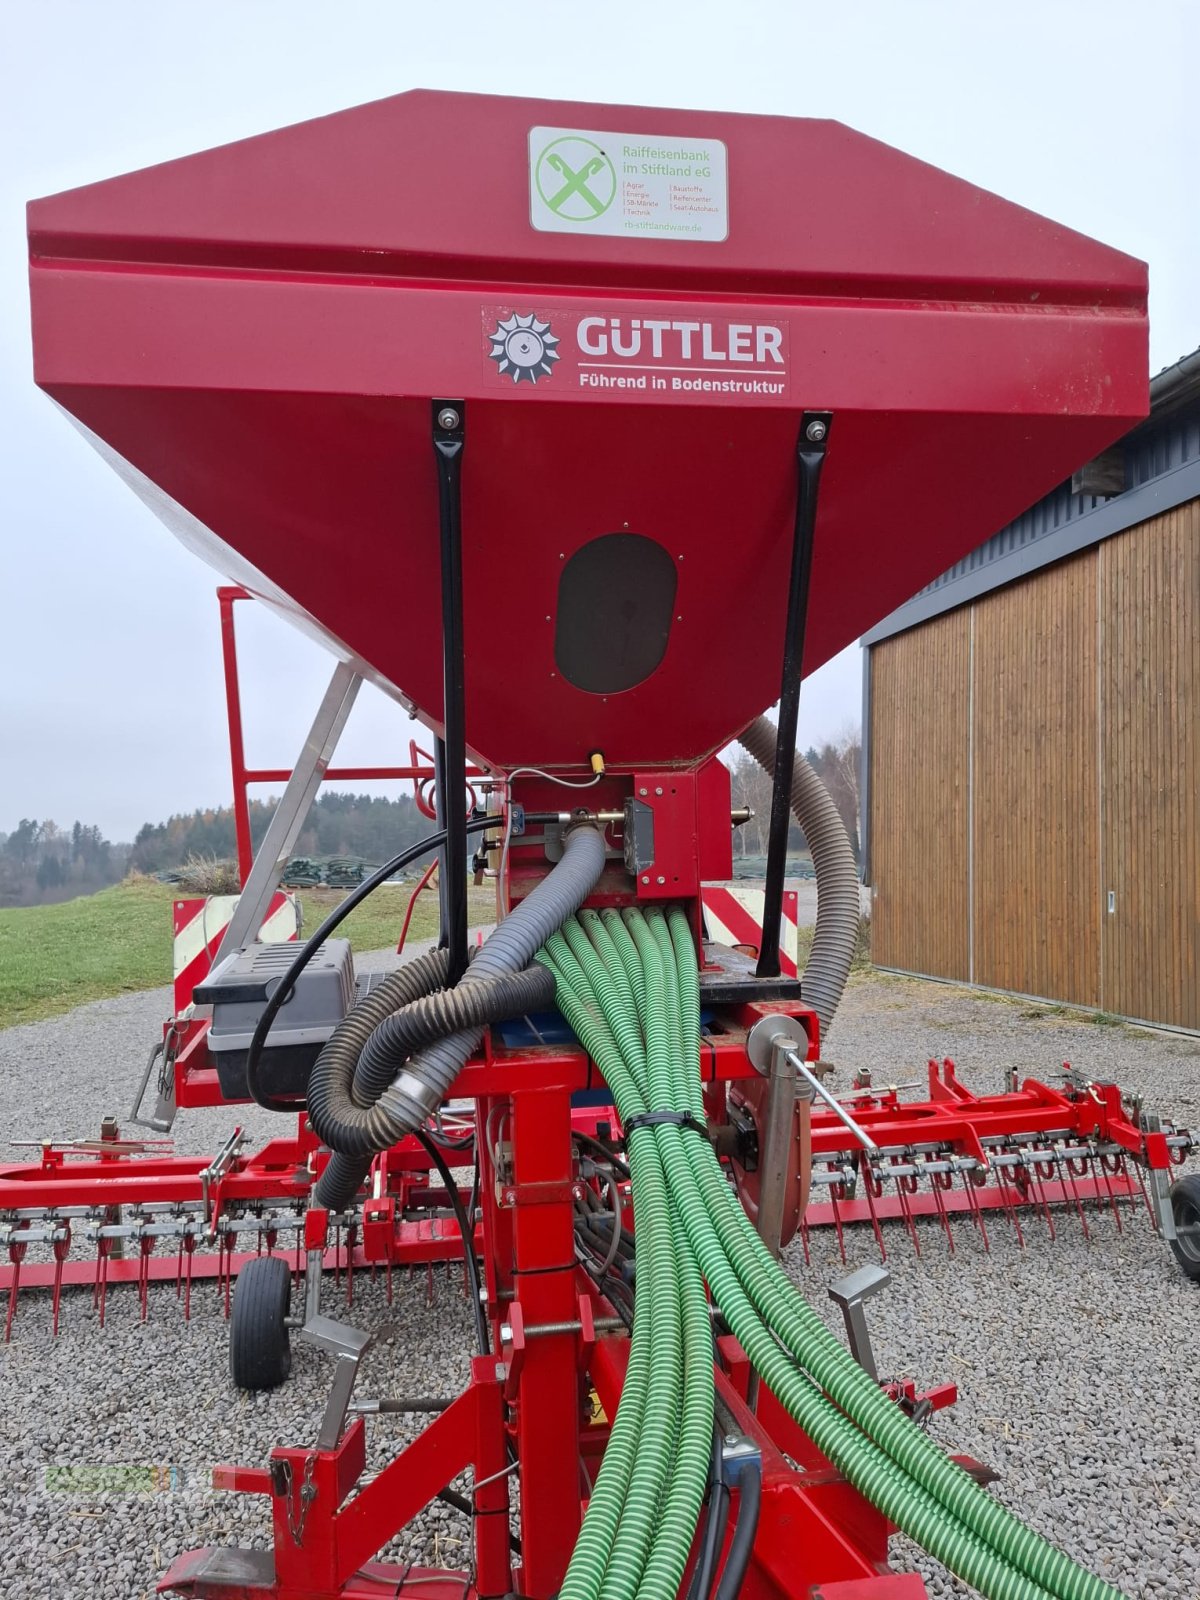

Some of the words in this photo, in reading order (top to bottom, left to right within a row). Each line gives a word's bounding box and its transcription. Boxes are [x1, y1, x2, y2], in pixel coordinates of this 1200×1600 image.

[623, 145, 710, 161] Raiffeisenbank
[623, 162, 638, 174] im
[641, 163, 691, 176] Stiftland
[695, 166, 711, 177] eG
[626, 182, 645, 190] Agrar
[626, 191, 650, 199] Energie
[626, 199, 659, 207] SB-Märkte
[627, 208, 651, 216] Technik
[624, 221, 702, 233] rb-stiftlandware.de
[576, 316, 785, 364] GÜTTLER
[579, 373, 647, 389] Führend
[651, 375, 667, 390] in
[672, 377, 785, 394] Bodenstruktur
